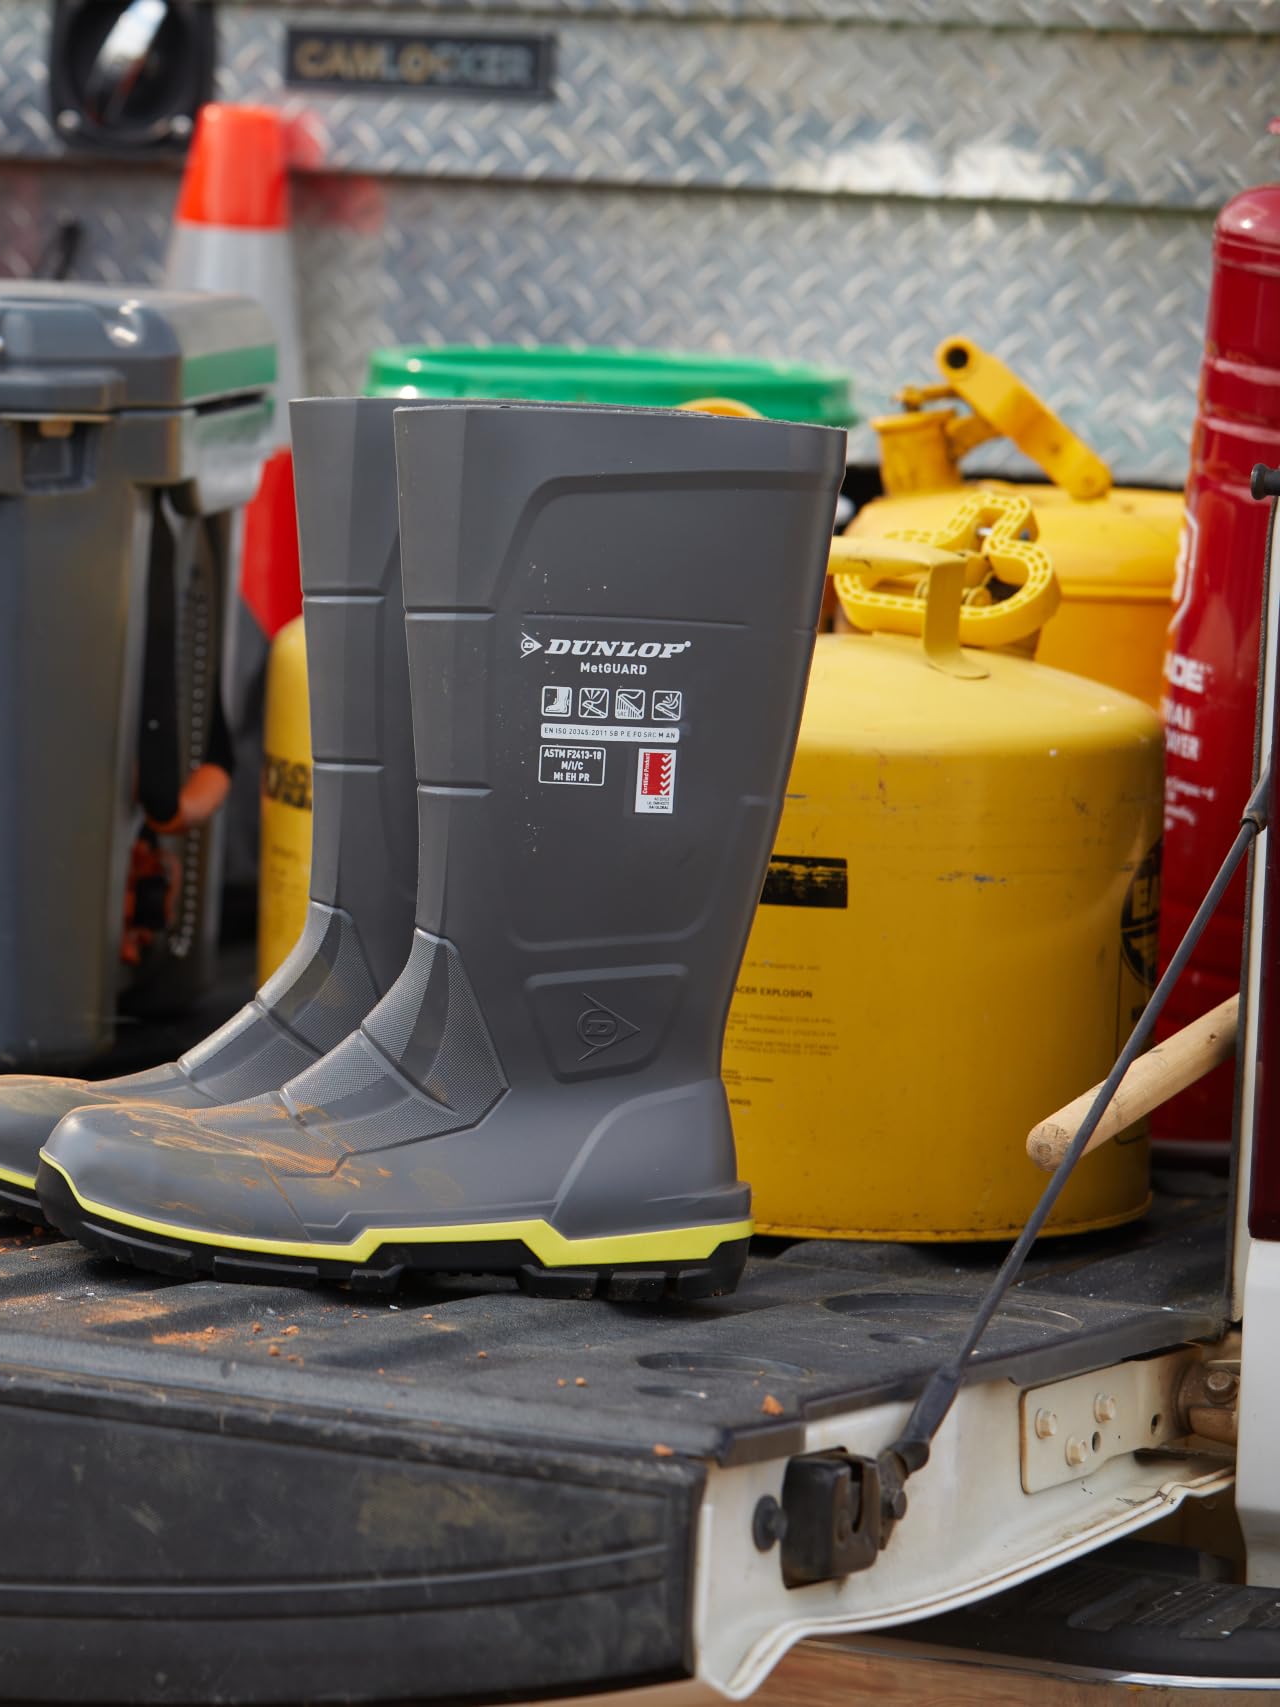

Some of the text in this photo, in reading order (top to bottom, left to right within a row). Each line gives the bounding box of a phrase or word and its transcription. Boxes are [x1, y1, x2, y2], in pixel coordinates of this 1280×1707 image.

[580, 661, 648, 676] MetGUARD
[555, 727, 567, 735] ISO
[569, 728, 607, 737] 20345:2011
[643, 731, 657, 739] SRC
[543, 748, 602, 760] ASTM F2413-18
[561, 760, 584, 771] M/I/C
[553, 771, 590, 782] Mt EH PR
[760, 987, 813, 999] EXPLOSION
